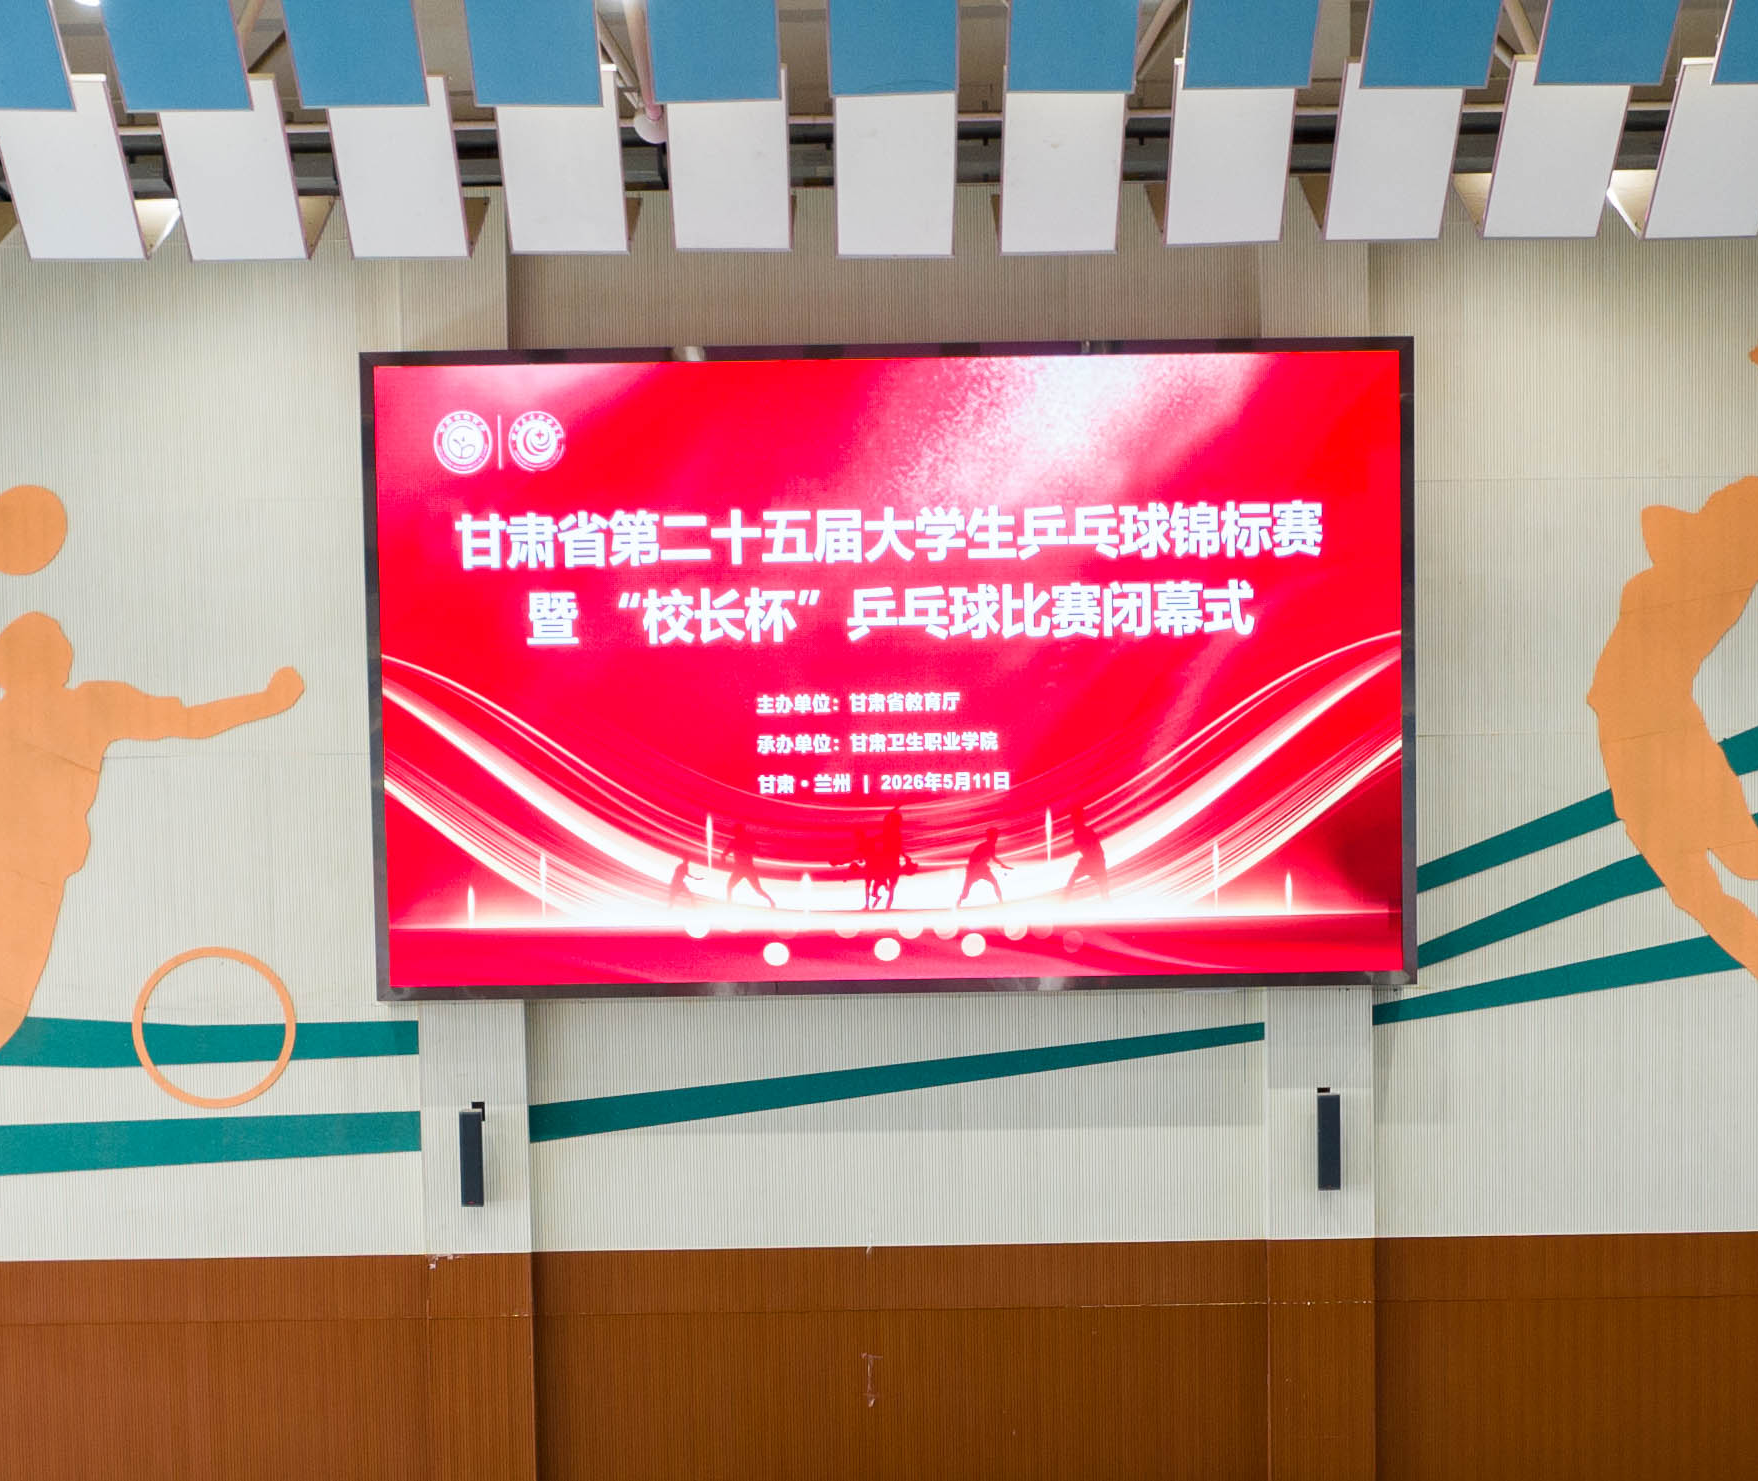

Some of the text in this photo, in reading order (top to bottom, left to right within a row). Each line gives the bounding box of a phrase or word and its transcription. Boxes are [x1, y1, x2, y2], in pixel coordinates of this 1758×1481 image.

[454, 500, 1323, 569] 甘肃省第二十五届大学生乒乓球锦标赛
